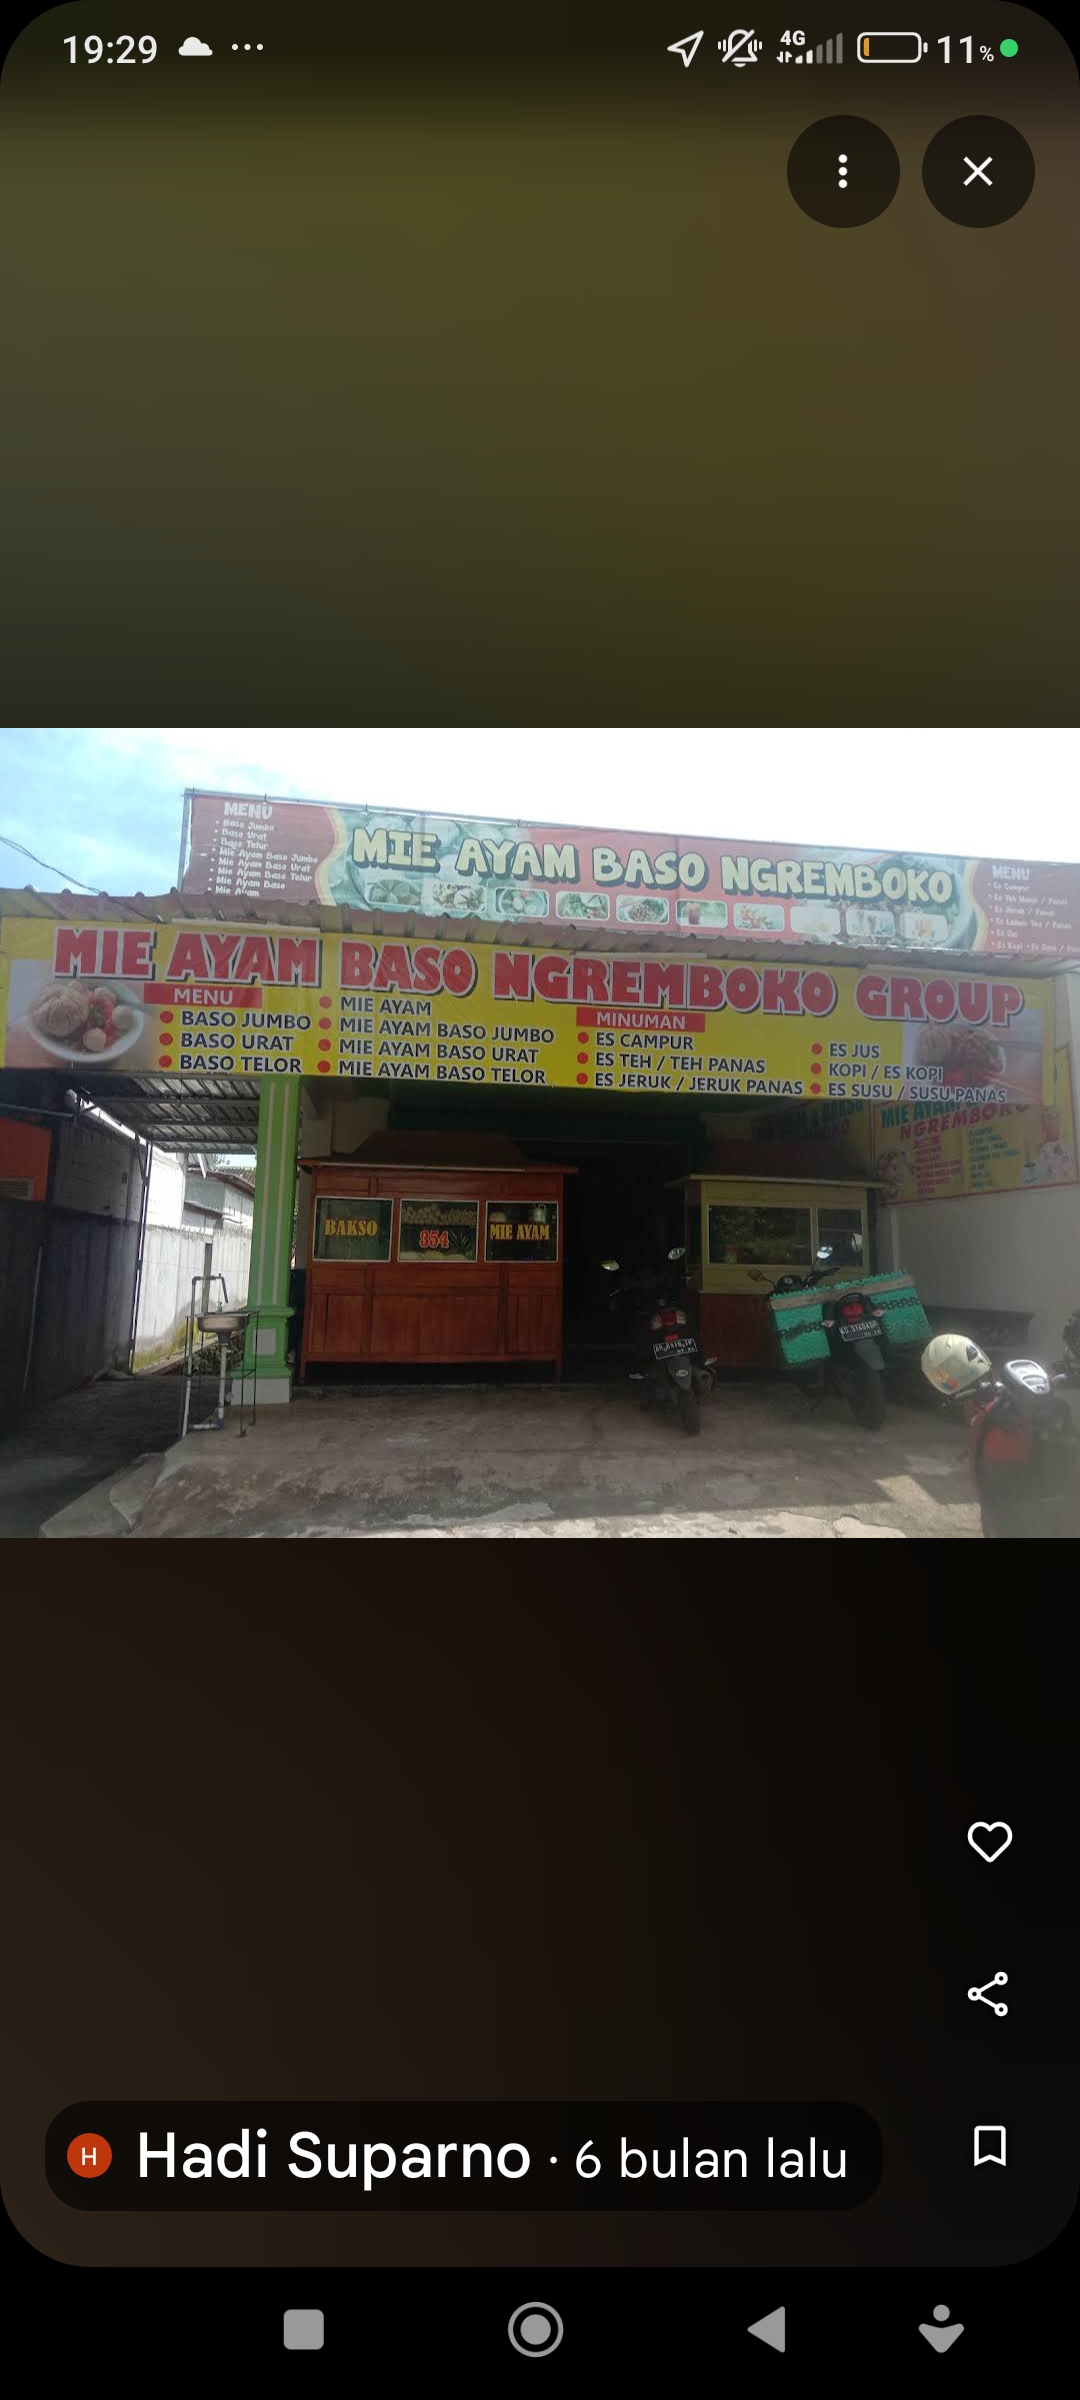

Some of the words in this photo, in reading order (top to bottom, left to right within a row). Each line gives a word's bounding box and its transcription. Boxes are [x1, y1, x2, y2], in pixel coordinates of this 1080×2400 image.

[224, 802, 273, 820] MENU
[222, 828, 243, 838] Baso
[247, 830, 267, 840] Urat
[223, 819, 244, 829] Baso
[248, 822, 274, 831] Jumbo
[221, 837, 242, 848] Baso
[247, 839, 269, 850] Telur
[219, 846, 235, 856] Mie
[239, 849, 262, 861] Ayam
[266, 851, 288, 861] Baso
[291, 853, 318, 863] Jumbo
[219, 857, 234, 866] Mie
[238, 858, 262, 871] Ayam
[265, 861, 287, 871] Baso
[291, 862, 311, 872] Urat
[352, 828, 440, 871] MIE
[455, 838, 580, 883] AYAM
[592, 846, 709, 892] BASO
[720, 855, 953, 904] NGREMBOKO
[992, 865, 1030, 881] MENU
[216, 876, 232, 885] Mie
[236, 878, 260, 890] Ayam
[263, 880, 285, 889] Baso
[218, 867, 233, 876] Mie
[237, 868, 261, 880] Ayam
[264, 870, 286, 880] Baso
[290, 872, 313, 882] Telur
[215, 885, 231, 894] Mie
[54, 926, 157, 980] MIE
[166, 931, 323, 988] AYAM
[339, 939, 478, 998] BASO
[492, 950, 838, 1017] NGREMBOKO
[855, 973, 1024, 1028] GROUP
[173, 988, 233, 1006] MENU
[340, 996, 373, 1012] MIE
[378, 999, 432, 1016] AYAM
[181, 1011, 237, 1028] BASO
[241, 1013, 312, 1030] JUMBO
[596, 1011, 686, 1030] MINUMAN
[340, 1017, 373, 1033] MIE
[378, 1020, 431, 1037] AYAM
[437, 1023, 486, 1039] BASO
[492, 1026, 555, 1044] JUMBO
[181, 1033, 236, 1049] BASO
[242, 1035, 294, 1051] URAT
[596, 1032, 615, 1047] ES
[620, 1033, 694, 1050] CAMPUR
[339, 1039, 373, 1055] MIE
[378, 1041, 430, 1058] AYAM
[437, 1044, 486, 1060] BASO
[492, 1047, 539, 1064] URAT
[829, 1043, 847, 1057] ES
[851, 1044, 880, 1059] JUS
[180, 1055, 235, 1072] BASO
[241, 1056, 302, 1073] TELOR
[339, 1060, 372, 1076] MIE
[378, 1062, 430, 1080] AYAM
[436, 1066, 485, 1081] BASO
[491, 1067, 546, 1084] TELOR
[596, 1052, 614, 1067] ES
[620, 1053, 651, 1069] TEH
[670, 1055, 702, 1071] TEH
[708, 1057, 765, 1074] PANAS
[829, 1063, 867, 1078] KOPI
[884, 1066, 901, 1080] ES
[906, 1066, 943, 1082] KOPI
[595, 1072, 614, 1087] ES
[618, 1074, 671, 1090] JERUK
[688, 1076, 741, 1093] JERUK
[746, 1079, 803, 1095] PANAS
[828, 1083, 846, 1097] ES
[851, 1084, 893, 1099] SUSU
[909, 1086, 950, 1101] SUSU
[956, 1088, 1007, 1103] PANAS
[881, 1107, 909, 1129] MIE
[323, 1219, 378, 1237] BAKSO
[490, 1223, 513, 1241] MIE
[517, 1223, 550, 1241] AYAM
